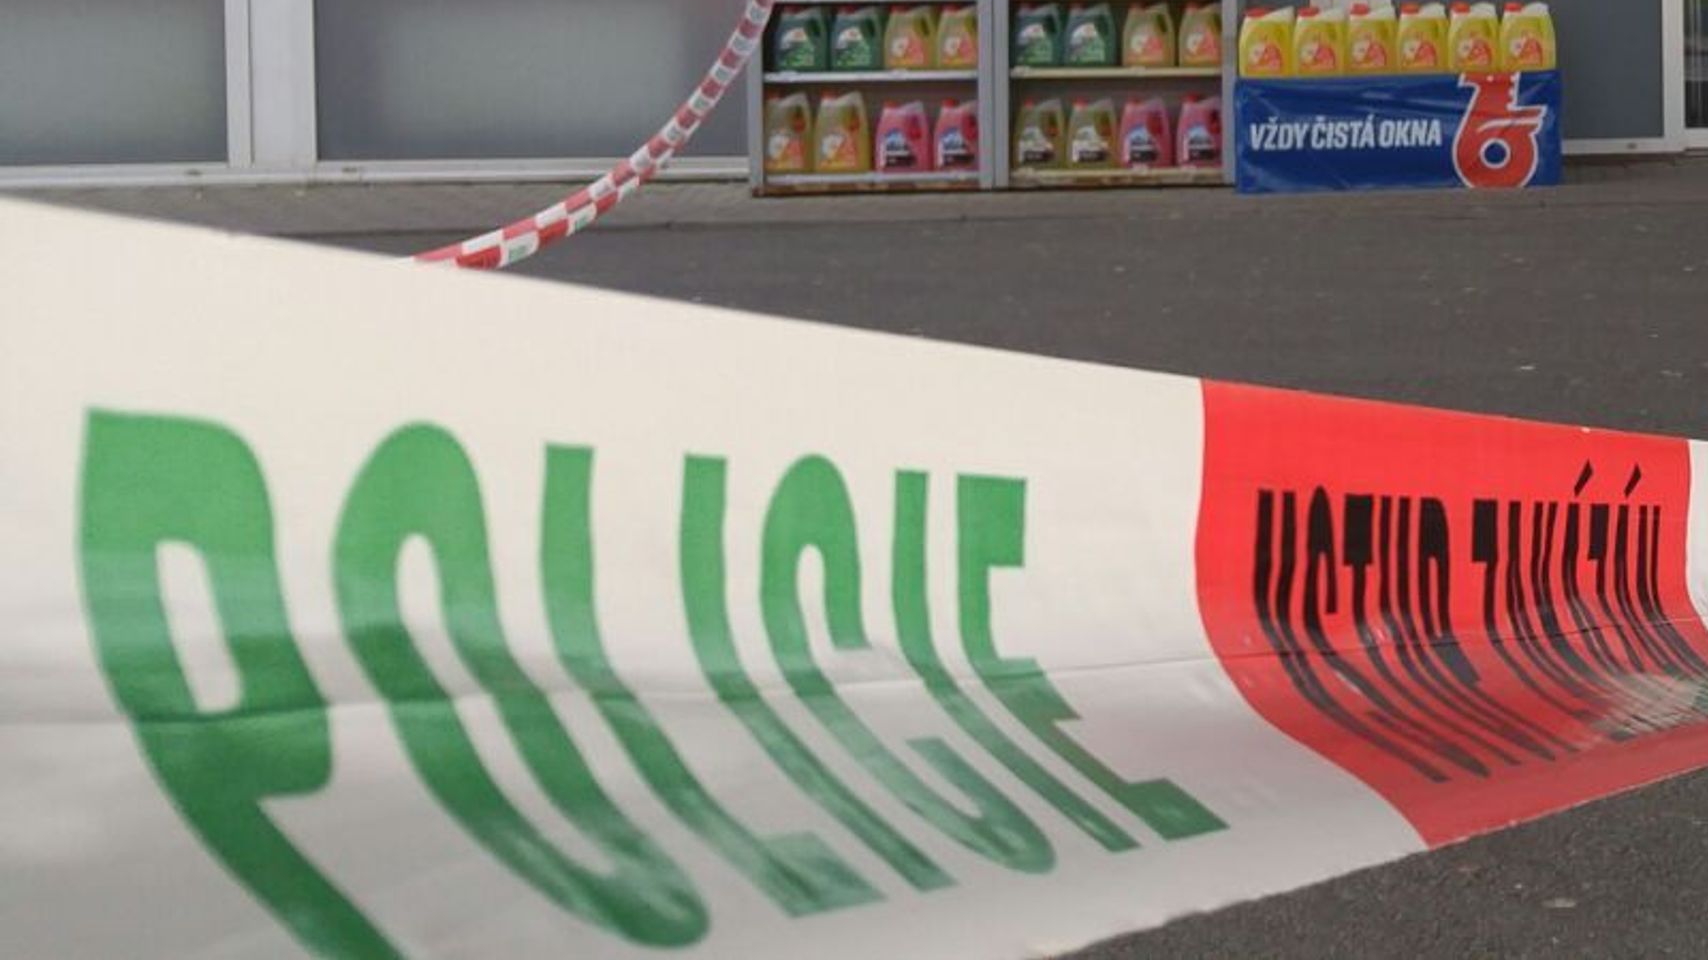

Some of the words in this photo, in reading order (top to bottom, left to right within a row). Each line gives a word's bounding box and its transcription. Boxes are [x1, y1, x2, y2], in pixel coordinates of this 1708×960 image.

[1250, 115, 1308, 151] VŽDY
[1310, 113, 1375, 150] ČISTÁ
[1377, 119, 1442, 148] OKNA
[79, 407, 1231, 960] POLICIE
[1252, 485, 1582, 783] VSTUP
